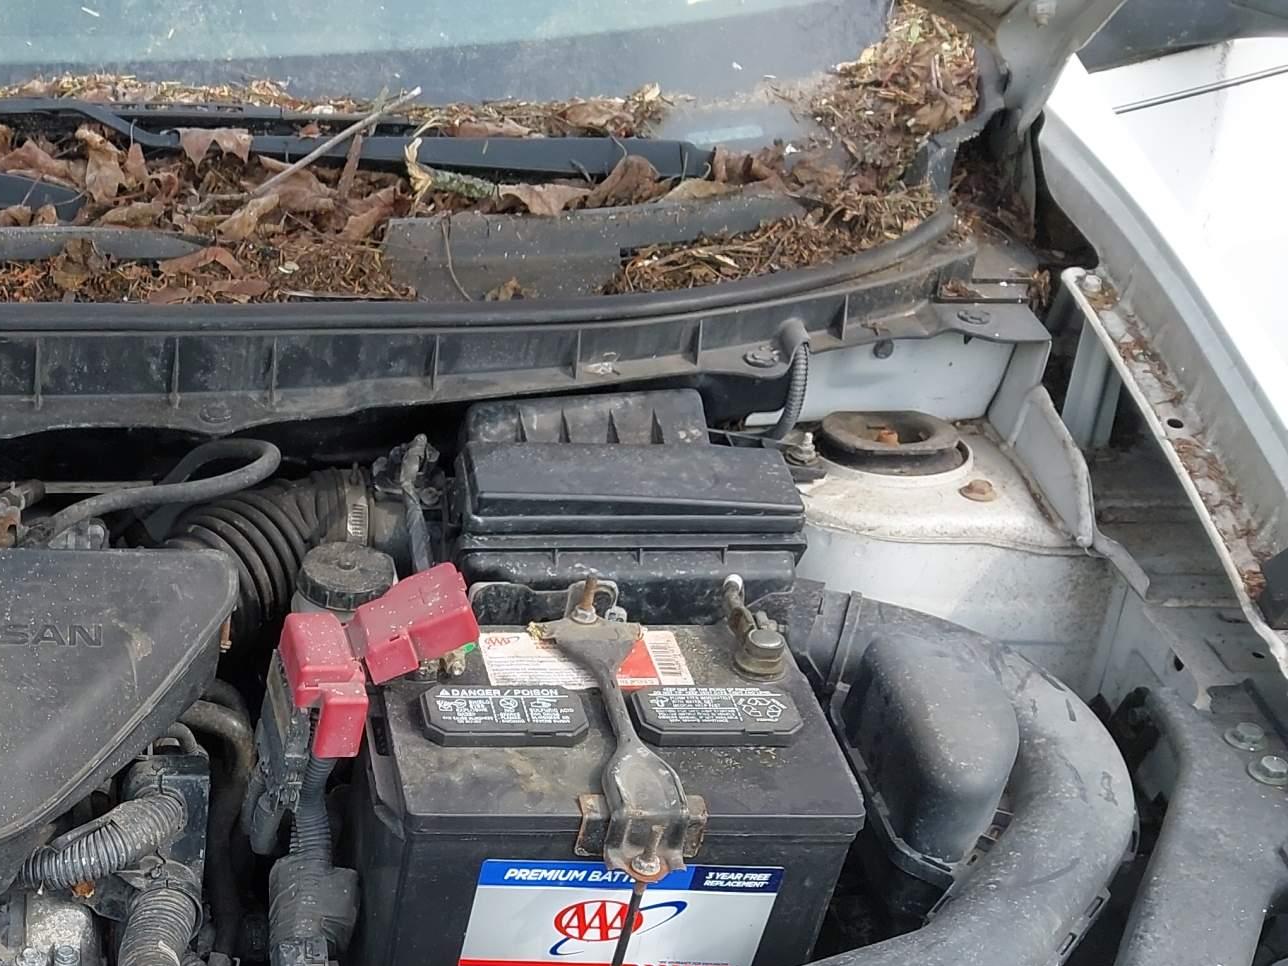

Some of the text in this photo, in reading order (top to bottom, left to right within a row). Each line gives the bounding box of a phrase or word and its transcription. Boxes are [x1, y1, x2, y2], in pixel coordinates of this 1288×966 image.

[504, 868, 587, 881] PREMIUM
[705, 871, 715, 879] 3
[715, 872, 743, 880] YEAR
[562, 901, 631, 940] AAA
